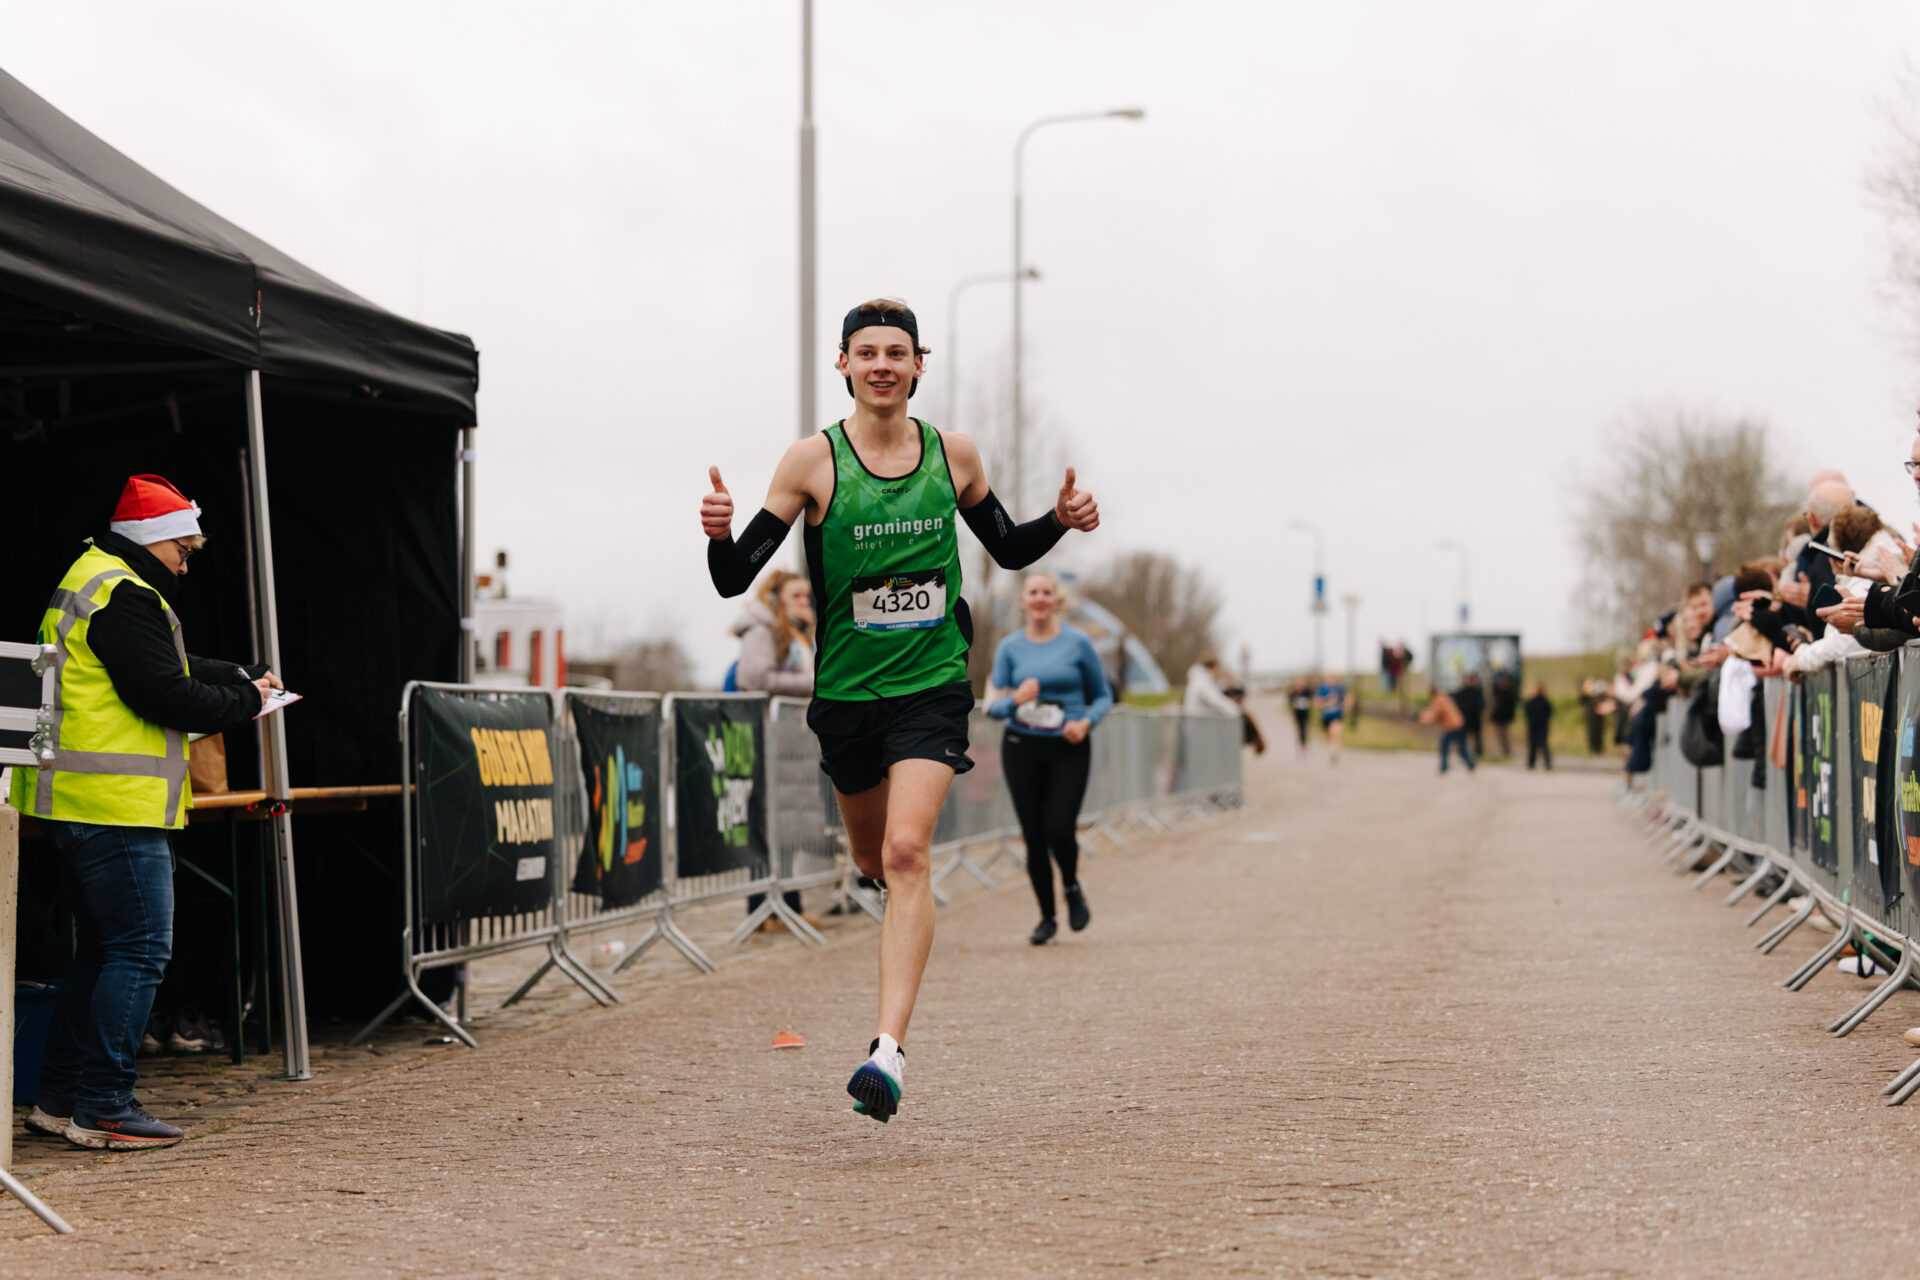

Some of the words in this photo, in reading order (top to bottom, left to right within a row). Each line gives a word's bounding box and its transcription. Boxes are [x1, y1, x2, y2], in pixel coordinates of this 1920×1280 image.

[854, 517, 943, 540] groningen
[855, 533, 941, 550] atletiek
[872, 590, 930, 613] 4320
[495, 798, 554, 845] MARATH
